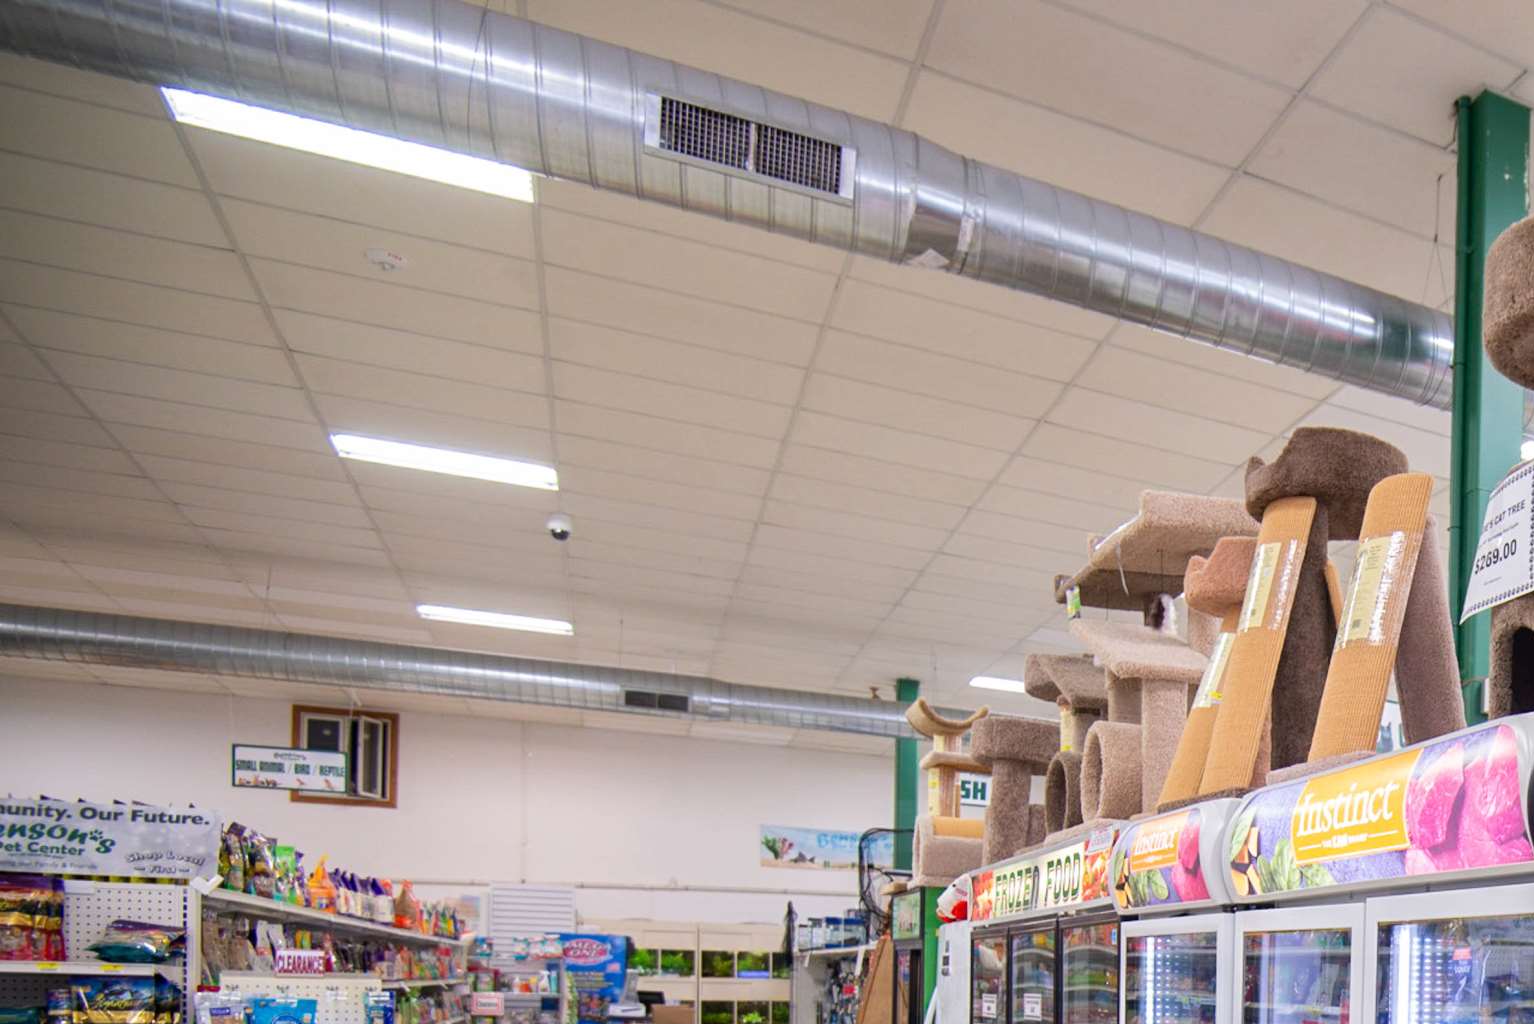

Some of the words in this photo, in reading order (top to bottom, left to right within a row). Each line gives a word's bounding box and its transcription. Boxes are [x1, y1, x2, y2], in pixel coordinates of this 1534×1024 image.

[1495, 510, 1506, 525] CAT
[1507, 499, 1526, 517] TREE
[80, 806, 123, 822] Our
[131, 809, 211, 826] Future.
[1295, 783, 1399, 838] Instinct
[27, 841, 86, 857] Center
[1044, 852, 1081, 907] FOOD
